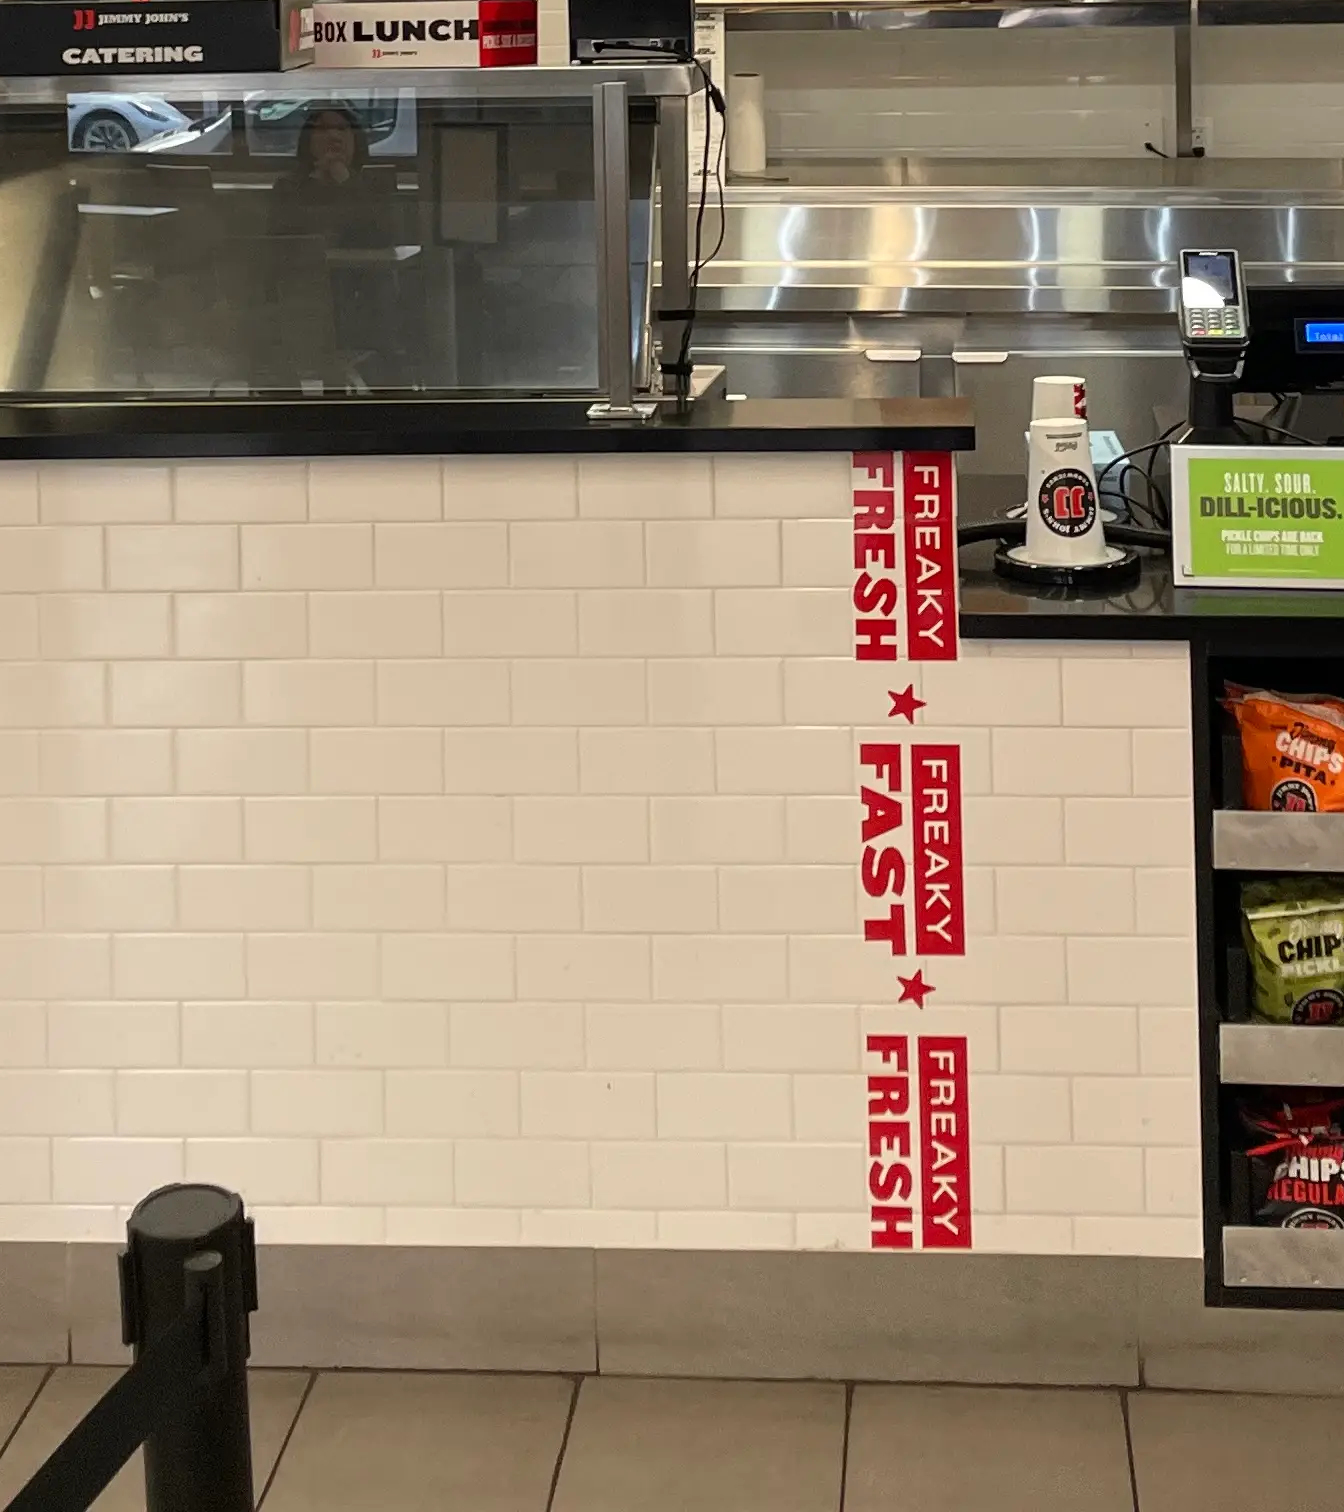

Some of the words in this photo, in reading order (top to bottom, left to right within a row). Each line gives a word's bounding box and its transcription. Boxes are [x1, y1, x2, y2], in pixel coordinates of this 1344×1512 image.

[62, 46, 203, 64] CATERING
[73, 10, 95, 30] JJ
[98, 13, 141, 25] JIMMY
[145, 12, 189, 23] JOHN'S
[314, 22, 347, 42] BOX
[353, 19, 479, 41] LUNCH
[853, 451, 898, 660] FRESH
[914, 464, 944, 648] FREAKY
[1200, 497, 1342, 519] DILL-ICIOUS.
[1224, 473, 1268, 494] SALTY.
[1275, 473, 1316, 494] SOUR.
[860, 744, 907, 956] FAST
[922, 759, 952, 943] FREAKY
[866, 1036, 913, 1249] FRESH
[929, 1051, 958, 1235] FREAKY
